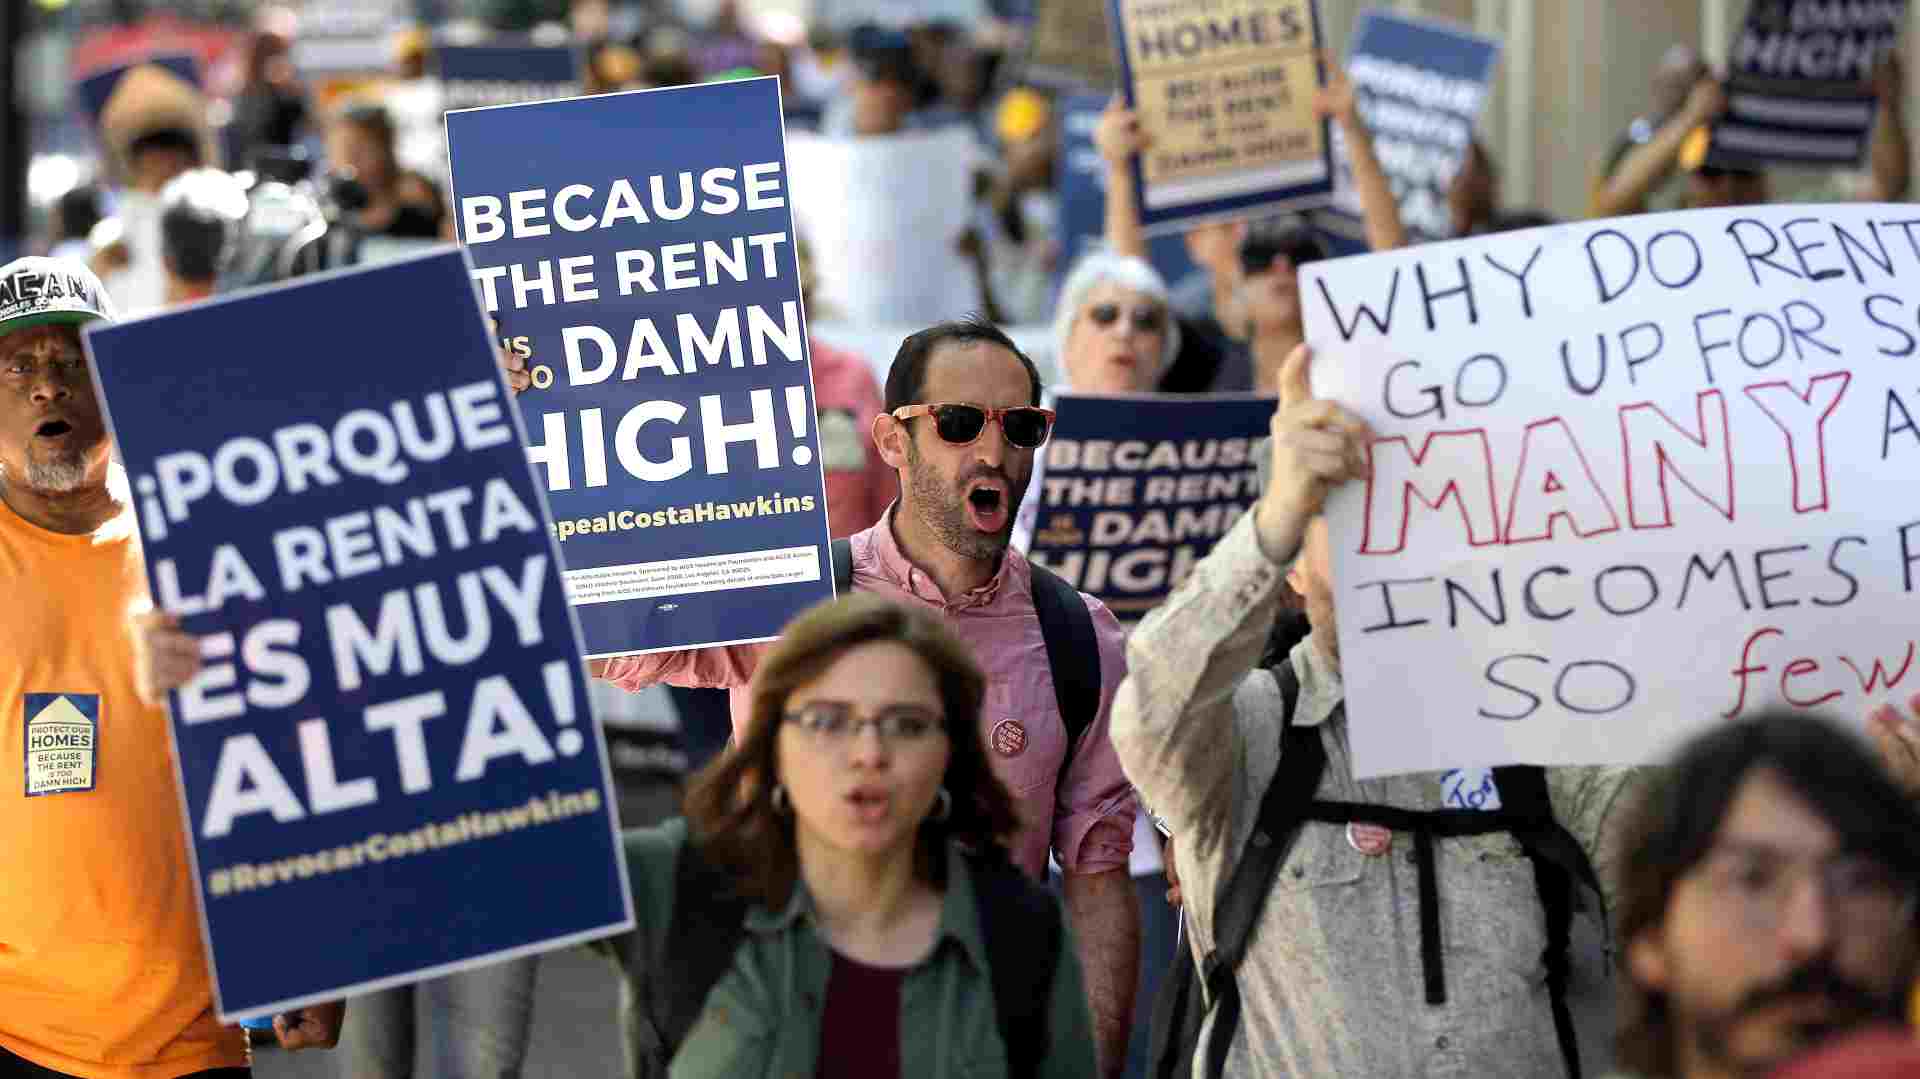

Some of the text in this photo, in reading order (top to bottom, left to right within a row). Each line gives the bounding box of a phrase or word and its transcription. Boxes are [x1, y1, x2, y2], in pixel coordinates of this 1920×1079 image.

[1138, 5, 1299, 59] HOMES
[462, 162, 784, 244] BECAUSE
[471, 232, 787, 312] THE RENT
[1317, 245, 1543, 342] WHY
[1585, 228, 1703, 304] DO
[562, 301, 803, 386] DAMN
[1382, 294, 1920, 421] GO UP FOR S
[136, 381, 512, 541] ¡PORQUE
[1046, 476, 1134, 506] THE
[1360, 370, 1920, 555] MANY A
[155, 477, 537, 617] LA RENTA
[549, 492, 815, 542] epealCostaHawkins
[1355, 535, 1867, 634] INCOMES
[176, 553, 548, 725] ES MUY
[1477, 627, 1916, 720] SO few
[31, 734, 91, 749] HOMES
[32, 726, 91, 735] PROTECT OUR
[37, 761, 83, 772] THE RENT
[38, 752, 81, 762] BECAUSE
[202, 660, 584, 838] ALTA!
[34, 776, 87, 789] DAMN HIGH
[56, 770, 73, 778] TOO
[208, 788, 600, 896] #RevocarCostaHawkins
